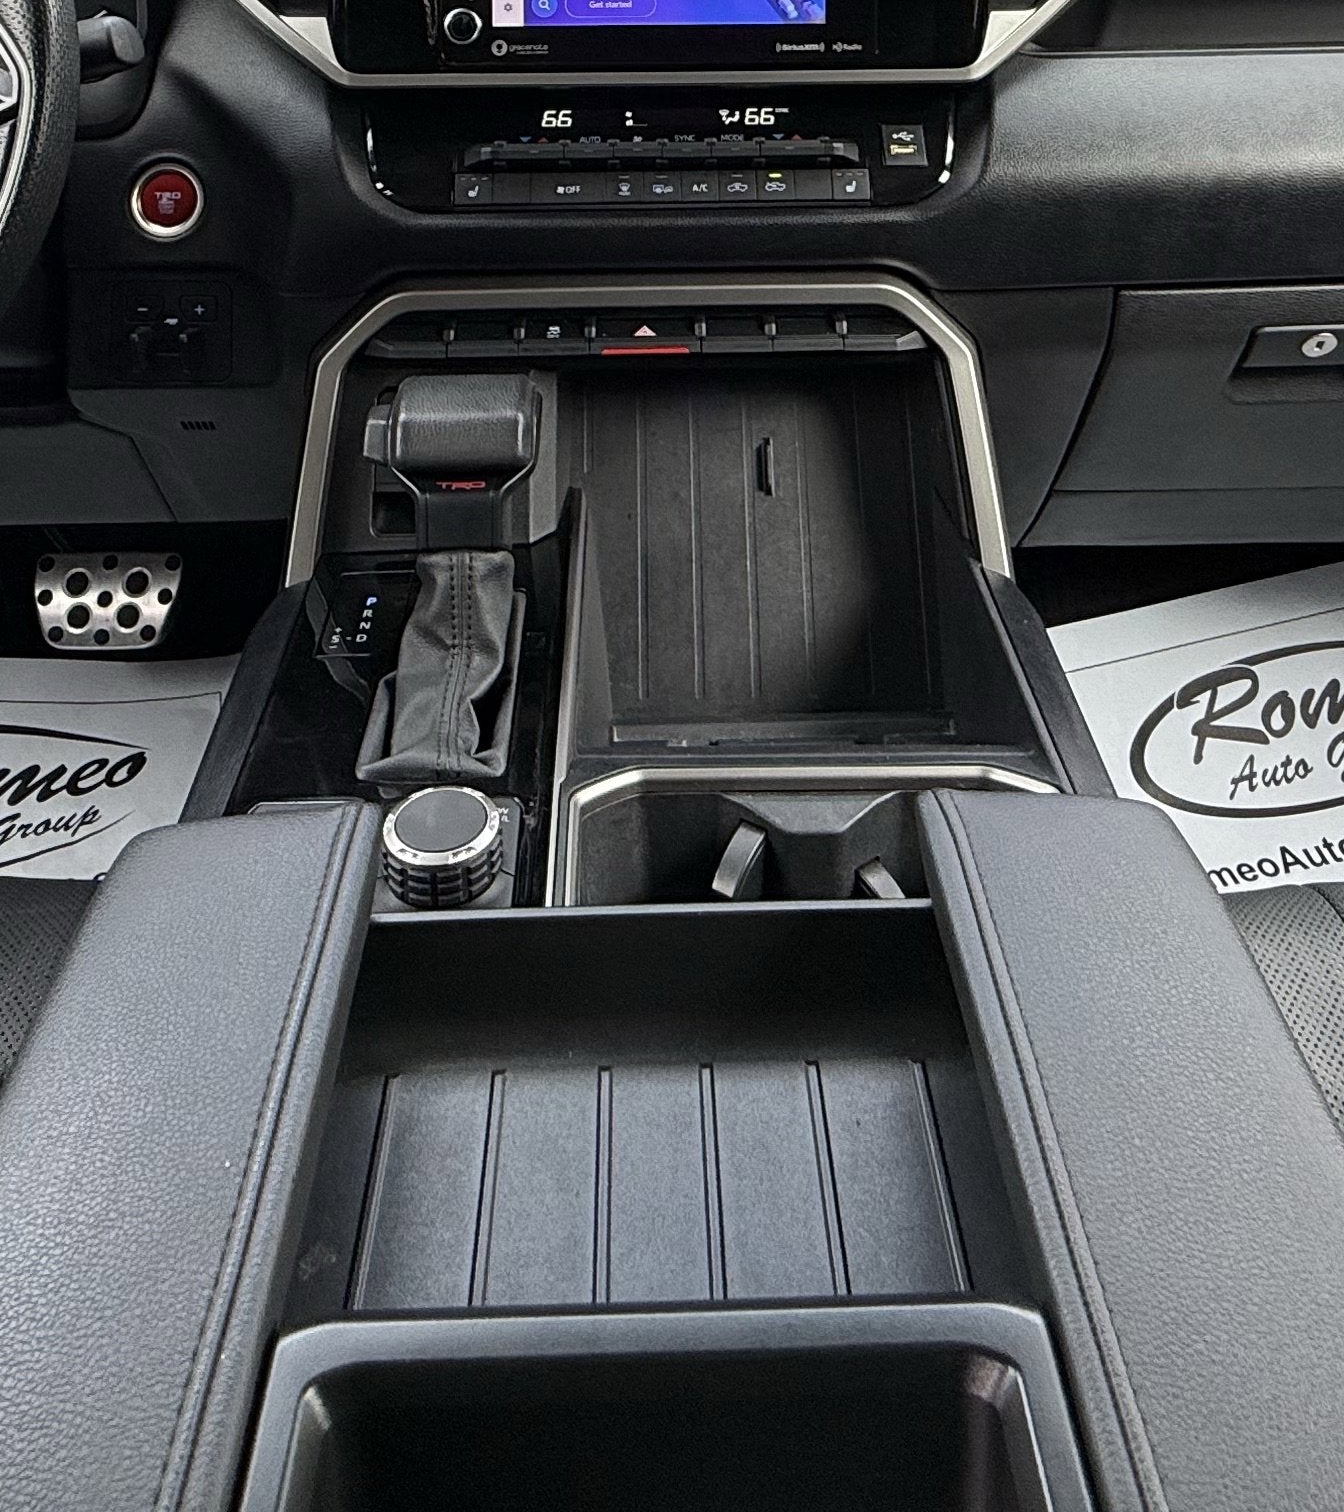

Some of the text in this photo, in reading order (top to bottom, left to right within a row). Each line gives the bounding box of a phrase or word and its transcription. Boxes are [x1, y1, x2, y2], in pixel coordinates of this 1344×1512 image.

[589, 0, 604, 9] Get
[540, 109, 573, 128] 66
[743, 107, 776, 126] 66
[579, 135, 602, 145] AUTO
[564, 185, 582, 194] OFF
[691, 183, 709, 194] A/C
[436, 481, 486, 490] TRD
[366, 596, 378, 607] P
[362, 609, 373, 618] R
[359, 621, 371, 630] N
[1229, 754, 1313, 800] Auto
